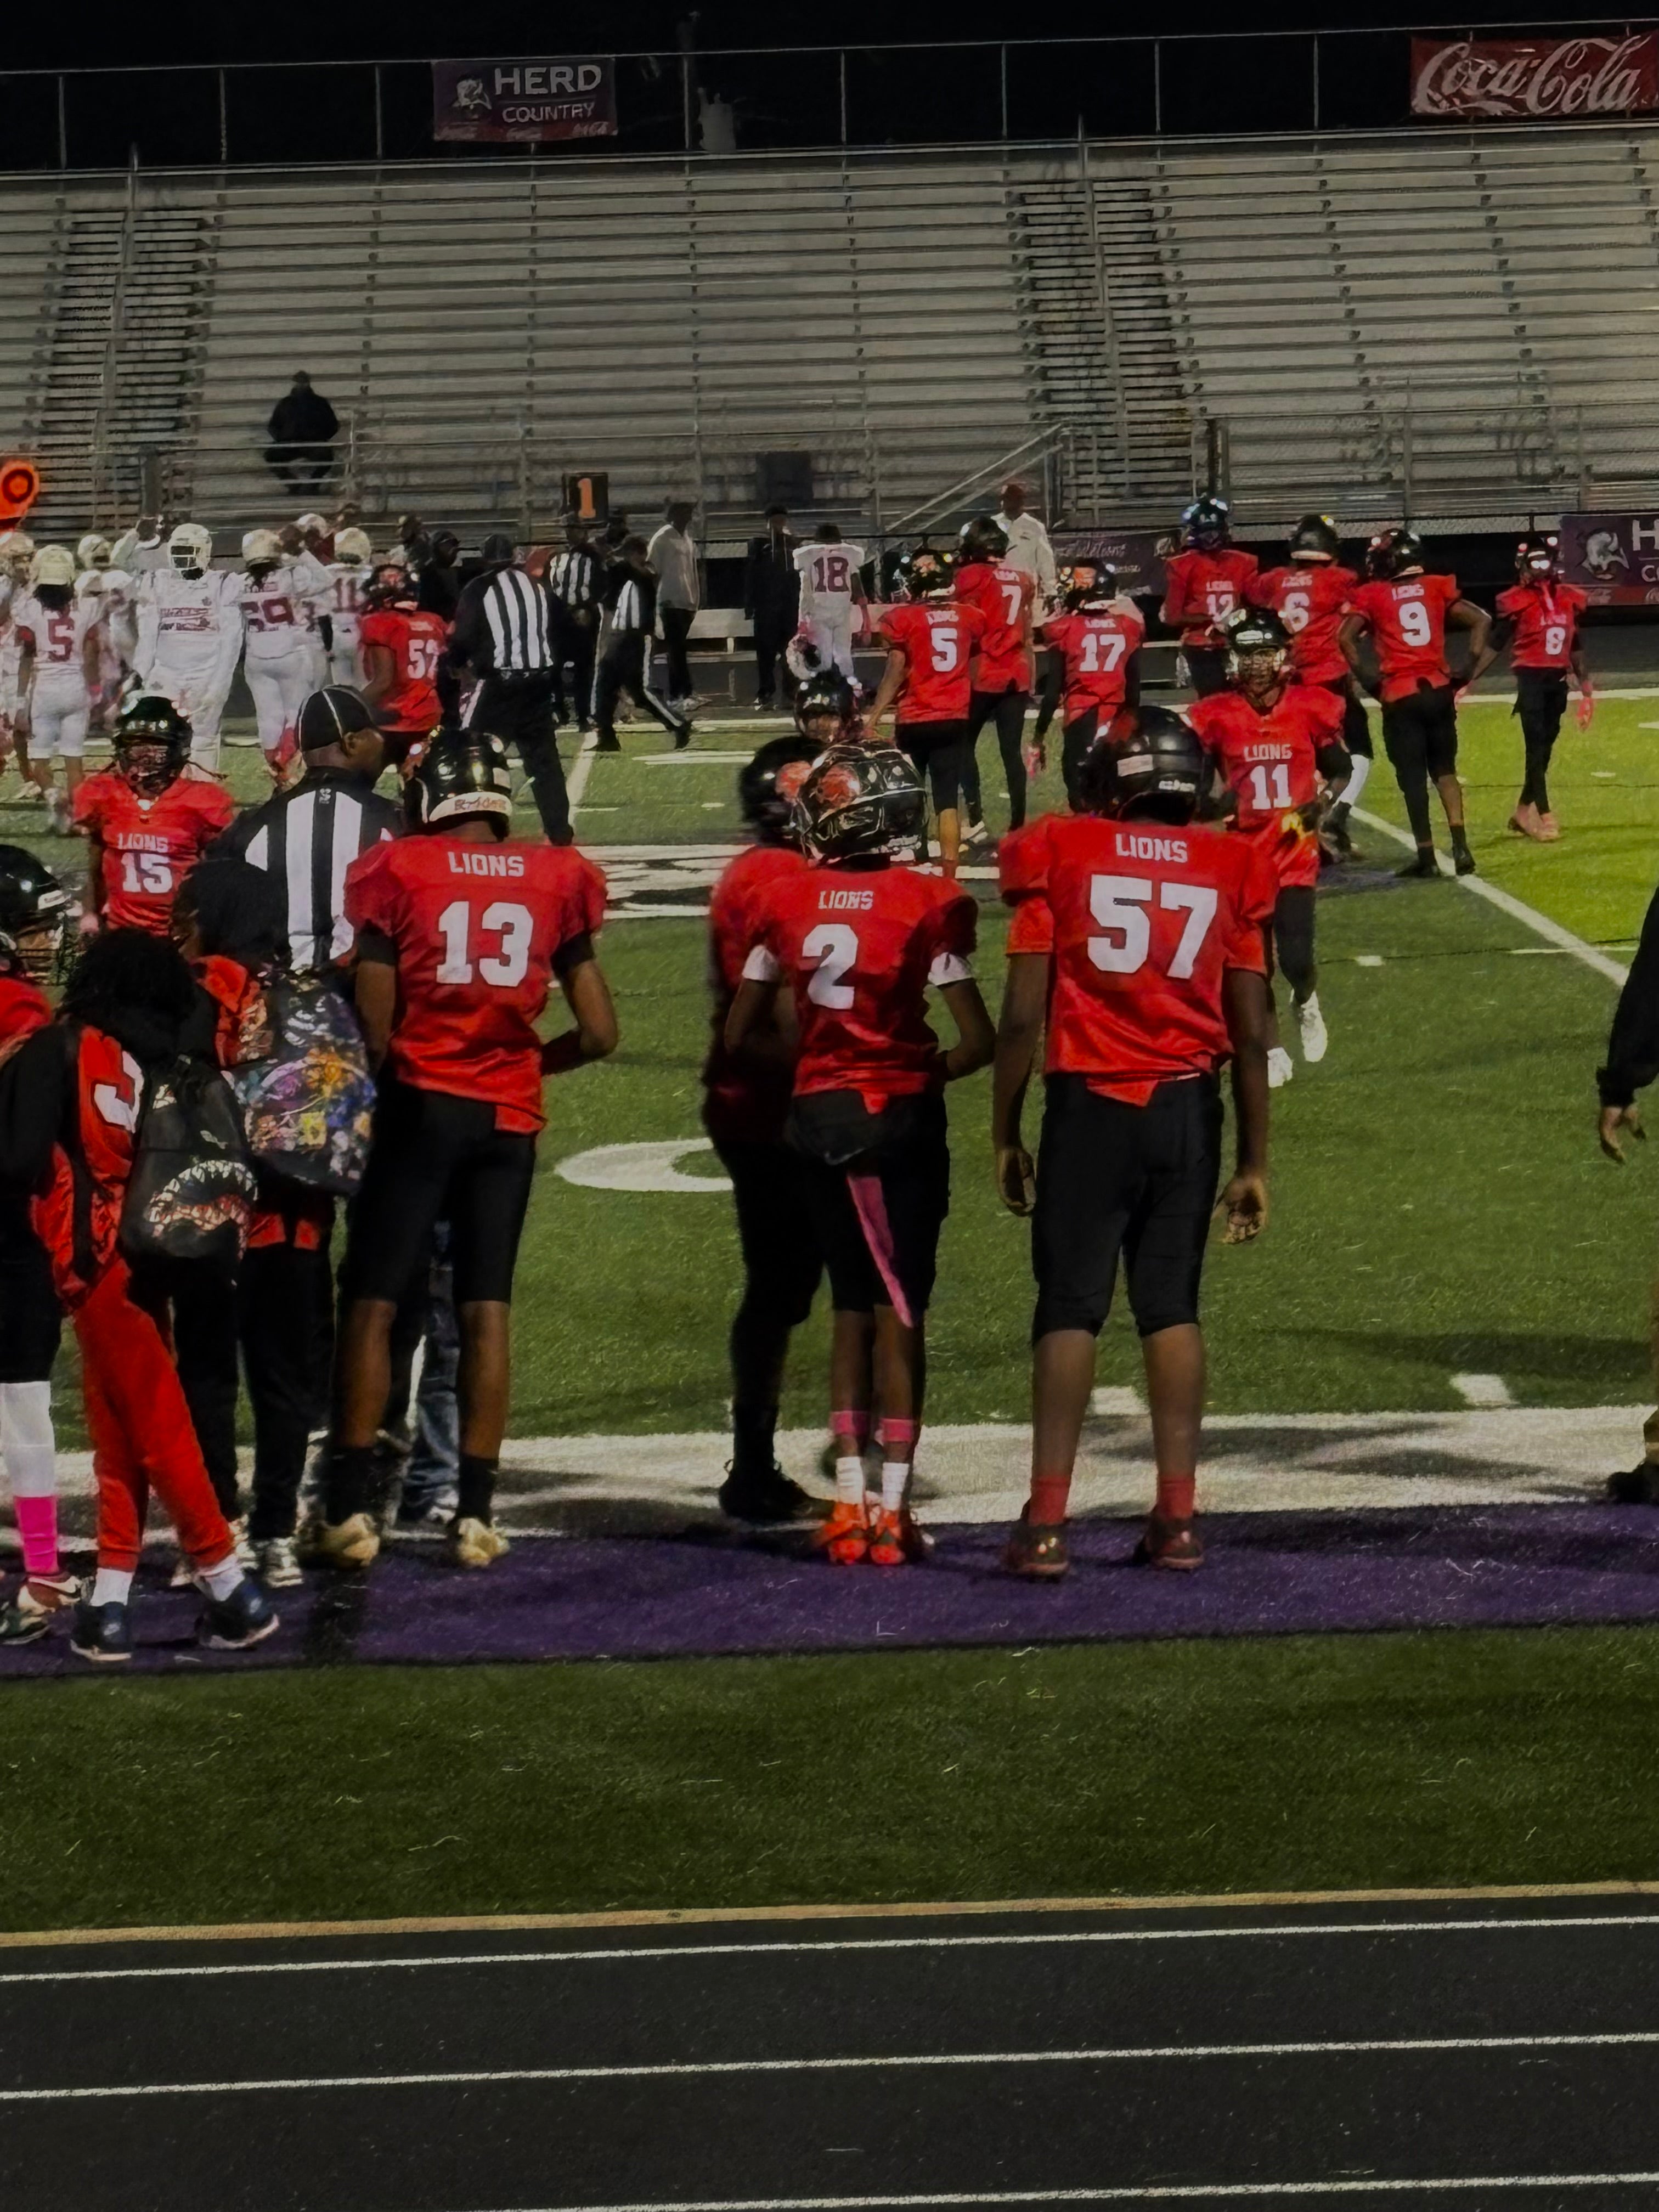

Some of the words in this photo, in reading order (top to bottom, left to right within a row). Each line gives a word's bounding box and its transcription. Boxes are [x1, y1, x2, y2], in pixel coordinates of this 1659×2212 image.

[494, 64, 602, 95] HERD
[1412, 35, 1651, 115] Coca-Cola
[502, 101, 595, 123] COUNTRY
[577, 478, 596, 519] 1
[813, 556, 849, 592] 18
[1001, 584, 1022, 625] 7
[1285, 592, 1310, 633] 6
[1399, 601, 1431, 646] 9
[48, 618, 75, 662] 5
[931, 627, 958, 672] 5
[1079, 633, 1126, 672] 17
[1243, 743, 1294, 762] LIONS
[1250, 764, 1293, 810] 11
[117, 832, 168, 853] LIONS
[1115, 833, 1188, 863] LIONS
[121, 852, 173, 894] 15
[447, 851, 524, 877] LIONS
[817, 890, 874, 911] LIONS
[436, 900, 534, 988] 13
[1087, 874, 1218, 980] 57
[802, 923, 859, 1010] 2
